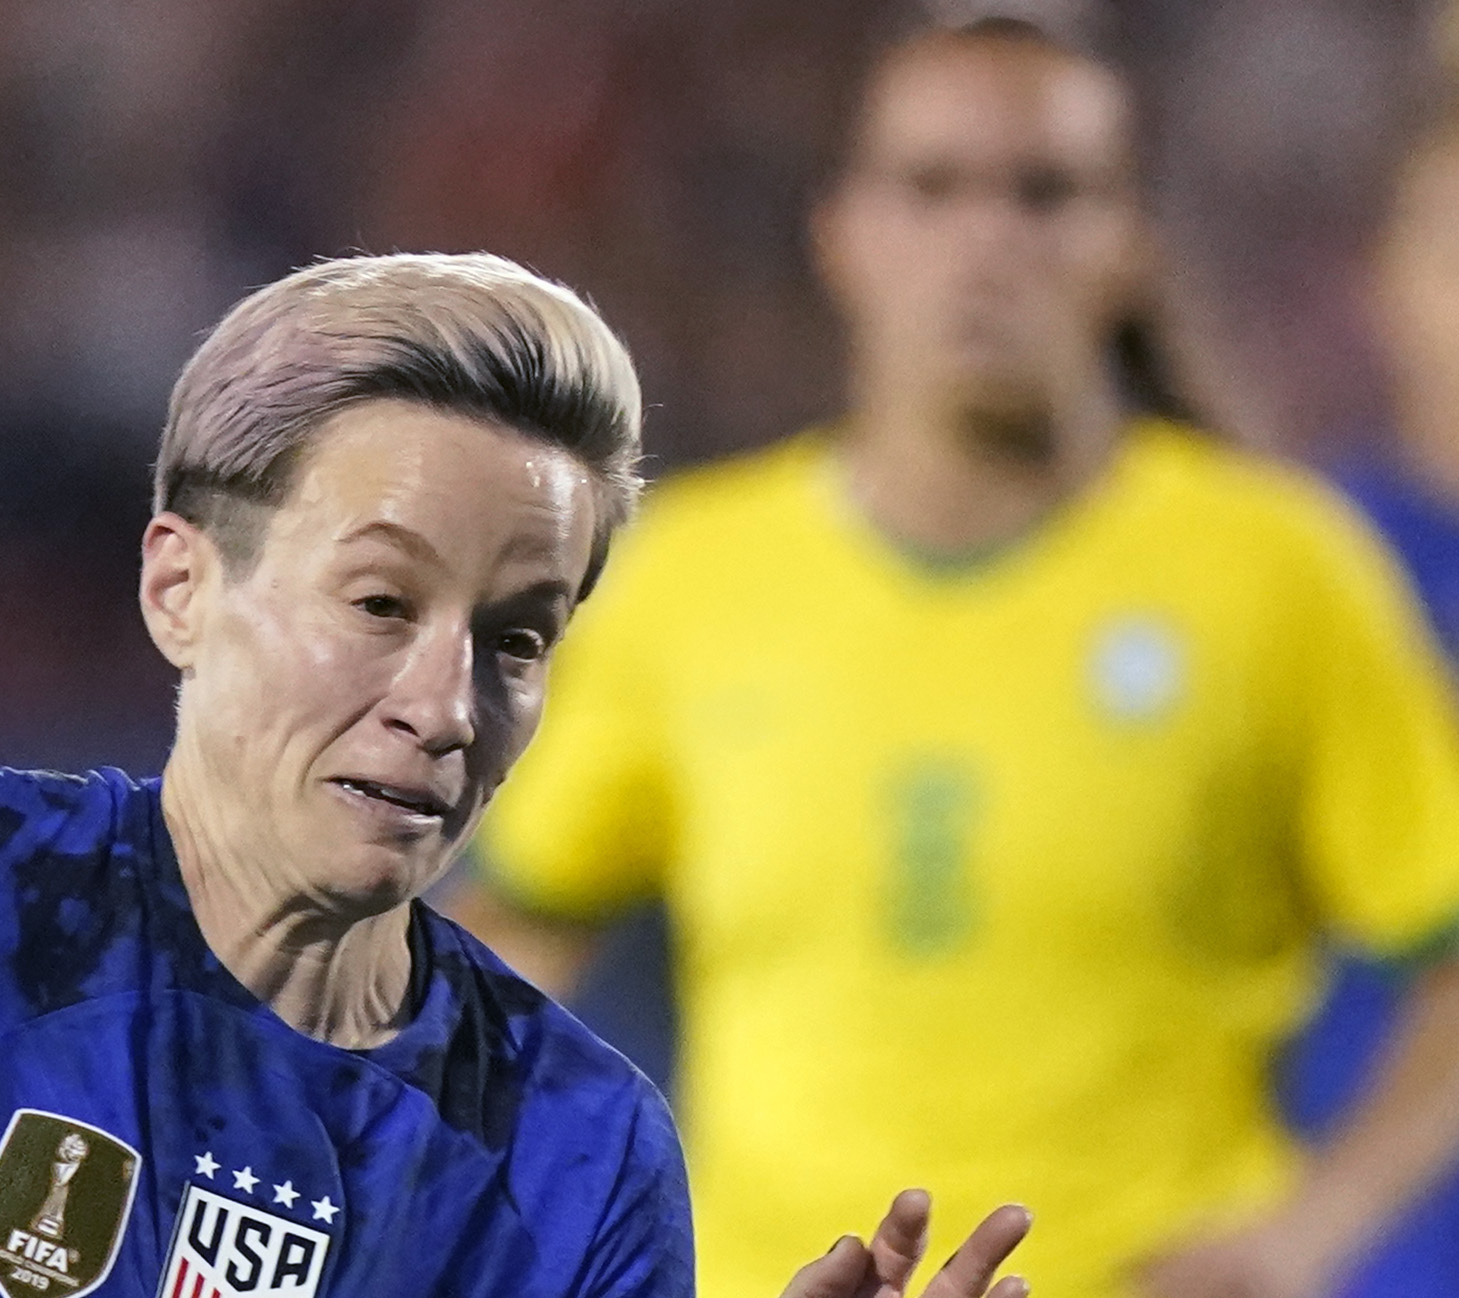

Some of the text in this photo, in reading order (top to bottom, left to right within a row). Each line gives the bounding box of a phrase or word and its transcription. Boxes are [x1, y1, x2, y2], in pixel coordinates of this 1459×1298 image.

[6, 1229, 68, 1273] FIFA
[188, 1200, 317, 1293] USA
[10, 1265, 50, 1291] 2019
